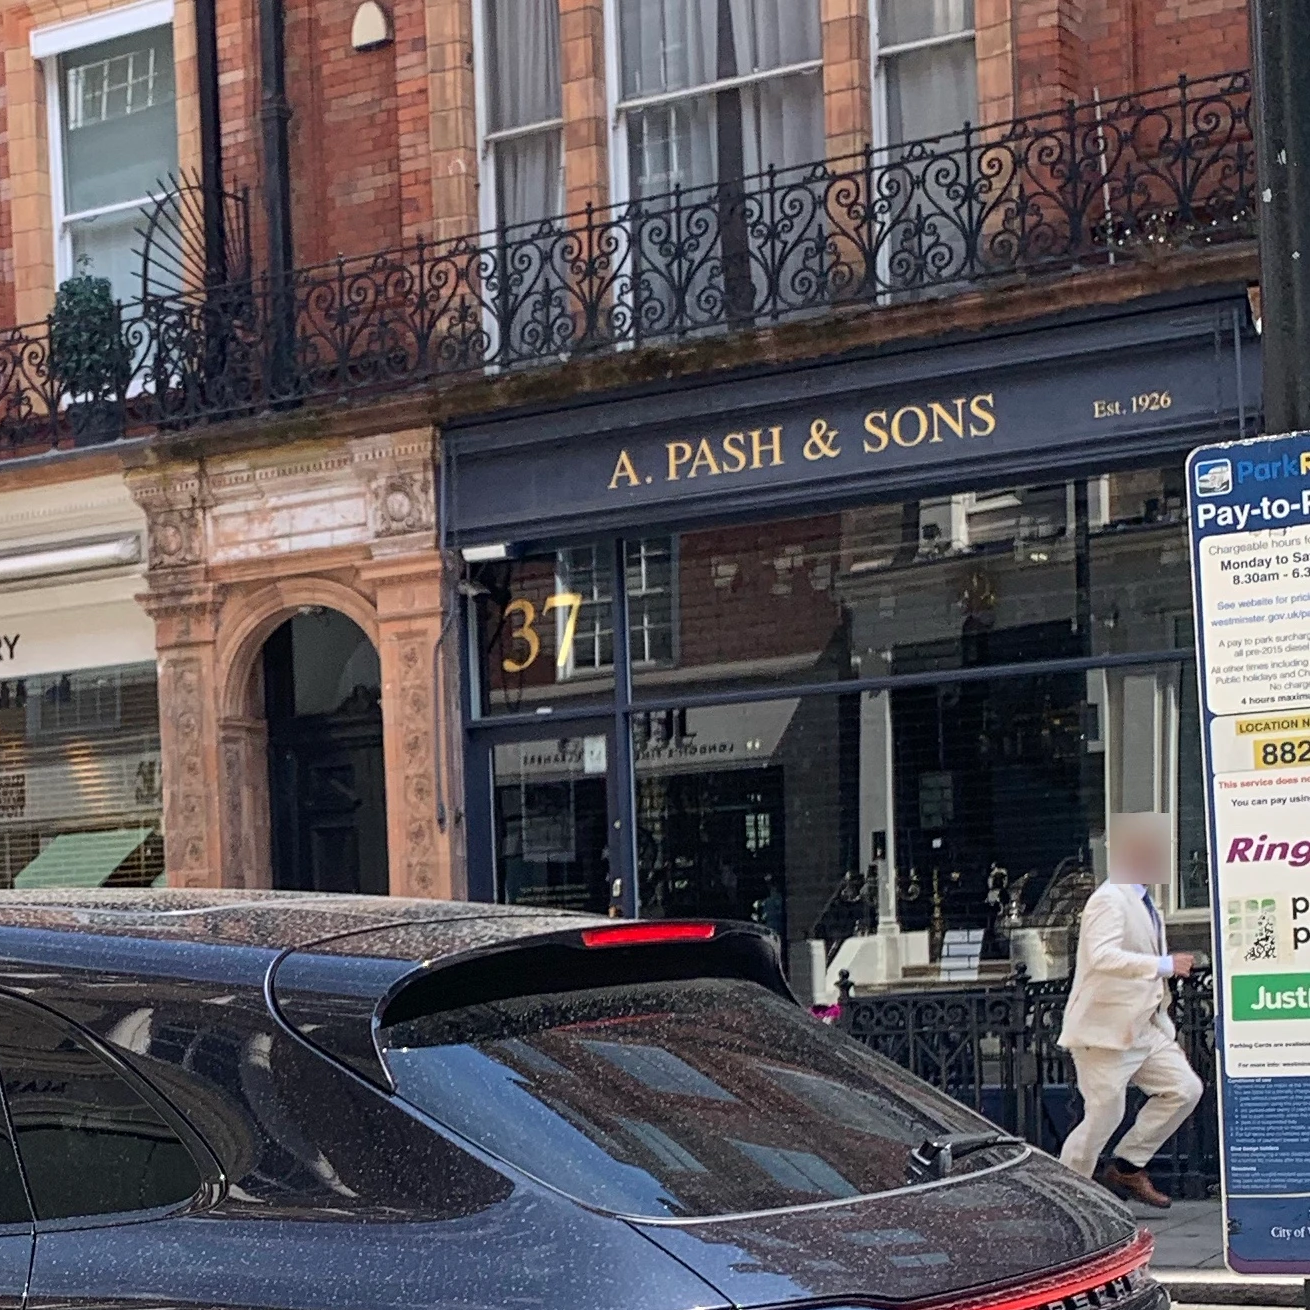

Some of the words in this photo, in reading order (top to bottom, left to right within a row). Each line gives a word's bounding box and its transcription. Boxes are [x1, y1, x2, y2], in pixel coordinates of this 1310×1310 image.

[1093, 399, 1124, 420] Est.
[1131, 391, 1171, 415] 1926
[608, 448, 653, 489] A.
[666, 427, 783, 481] PASH
[802, 420, 841, 460] &
[863, 394, 996, 454] SONS
[1209, 539, 1268, 556] Chargeable
[1272, 535, 1301, 548] hours
[1220, 556, 1272, 571] Monday
[1276, 554, 1288, 565] to
[1292, 552, 1310, 563] Sa
[1232, 571, 1279, 585] 8.30am
[1217, 601, 1236, 610] See
[1238, 597, 1273, 608] website
[1276, 594, 1288, 604] for
[502, 593, 582, 673] 37
[1218, 639, 1226, 647] A
[1227, 640, 1242, 649] pay
[1244, 637, 1253, 645] to
[1254, 635, 1273, 647] park
[1234, 649, 1244, 658] all
[1245, 646, 1283, 658] pre-2015
[1284, 643, 1309, 653] diesel
[1211, 666, 1221, 674] All
[1223, 664, 1244, 674] other
[1246, 662, 1269, 672] times
[1270, 658, 1309, 669] including
[1215, 674, 1240, 685] Public
[1242, 672, 1278, 684] holidays
[1279, 670, 1296, 679] and
[1269, 682, 1282, 691] No
[1249, 695, 1275, 704] hours
[1238, 719, 1298, 734] LOCATION
[1262, 740, 1310, 766] 882
[1218, 780, 1238, 789] This
[1240, 778, 1273, 788] service
[1275, 776, 1298, 785] does
[1231, 798, 1249, 807] You
[1251, 797, 1268, 806] can
[1270, 796, 1288, 807] pay
[1226, 834, 1310, 868] Ring
[1250, 985, 1310, 1011] Just
[1270, 1226, 1292, 1240] City
[1293, 1225, 1306, 1238] of
